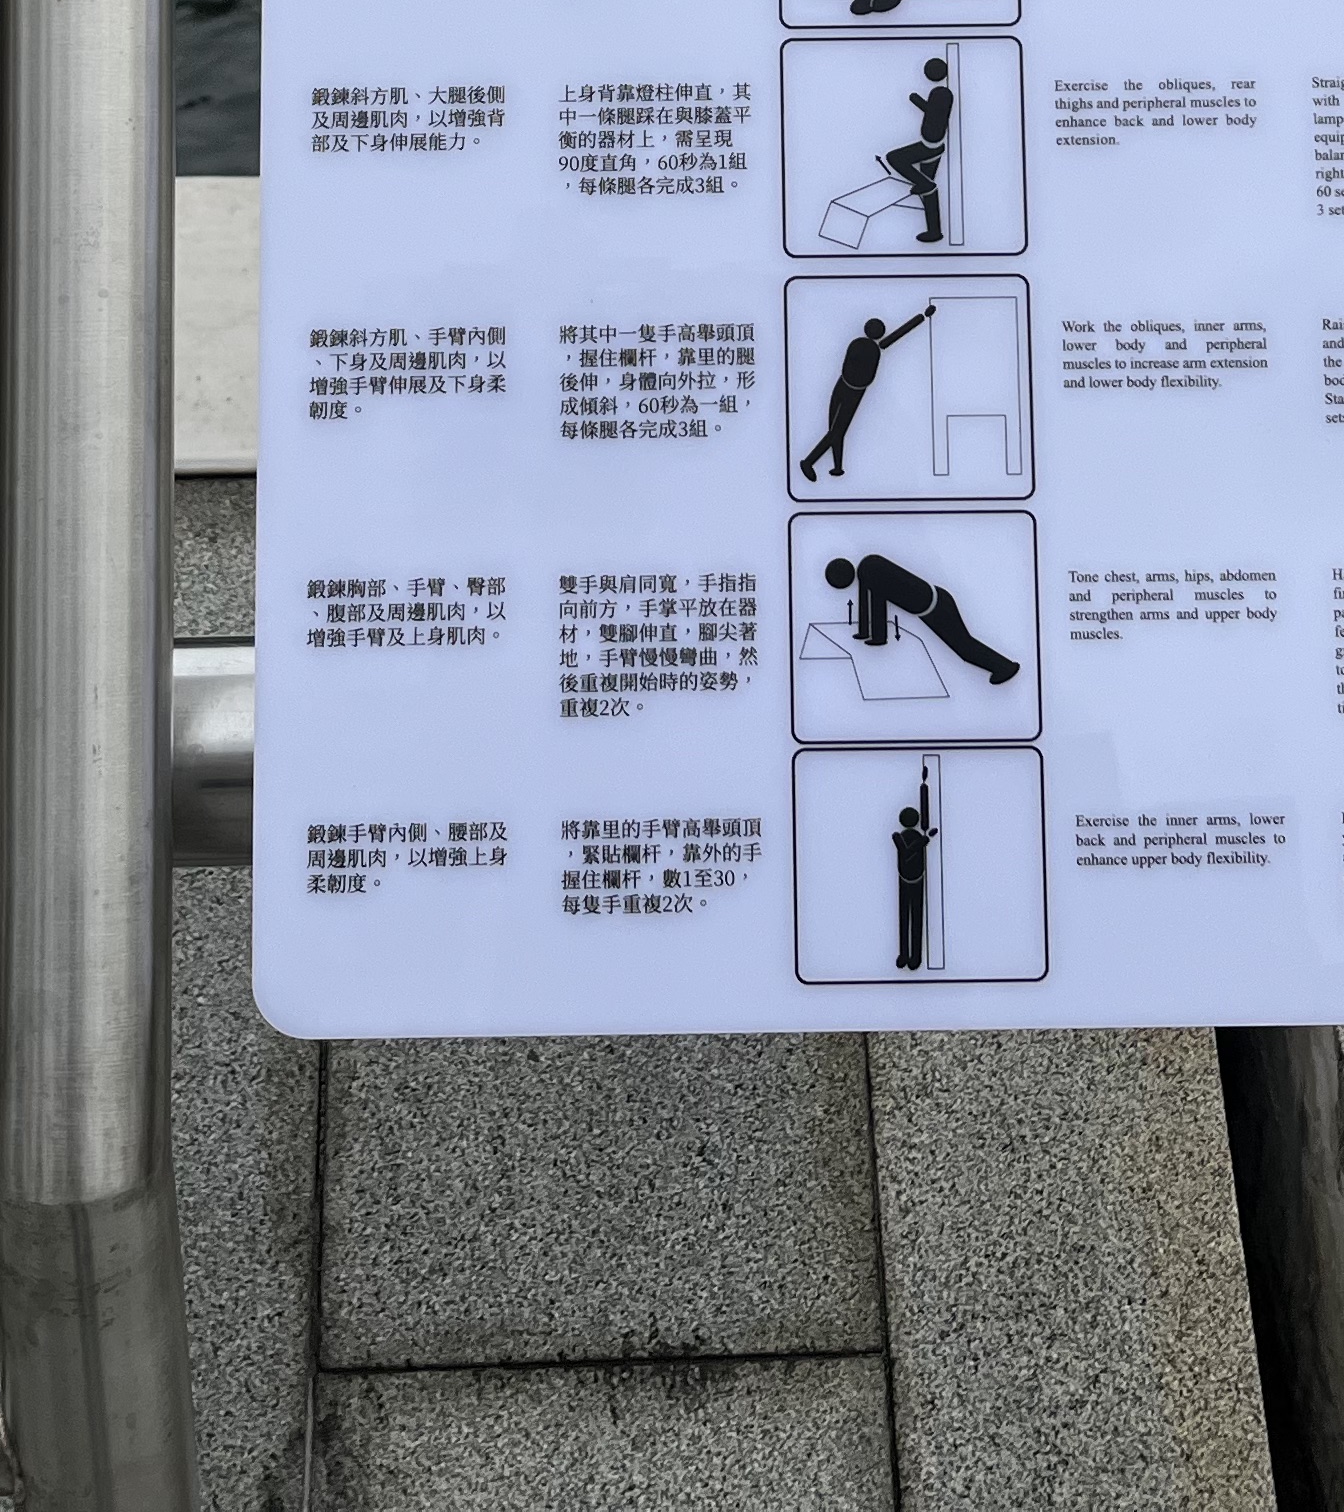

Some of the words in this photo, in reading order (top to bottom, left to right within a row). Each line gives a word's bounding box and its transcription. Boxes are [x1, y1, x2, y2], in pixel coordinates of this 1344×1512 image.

[1053, 79, 1109, 92] Exercise
[1123, 78, 1143, 91] the
[1158, 77, 1216, 94] obliques,
[1230, 80, 1257, 90] rear
[1312, 112, 1344, 128] lamp
[1062, 338, 1098, 352] lower
[1114, 338, 1146, 354] body
[1164, 337, 1188, 351] and
[1205, 336, 1268, 354] peripheral
[1067, 570, 1100, 584] Tone
[1104, 569, 1140, 584] chest,
[1145, 572, 1180, 585] arms,
[1183, 568, 1215, 586] hips,
[1219, 568, 1278, 582] abdomen
[1069, 607, 1134, 625] strengthen
[1139, 610, 1171, 621] arms
[1176, 606, 1200, 621] and
[1204, 610, 1241, 624] upper
[1245, 605, 1278, 623] body
[1075, 814, 1130, 828] Exercise
[1137, 813, 1158, 827] the
[1165, 816, 1199, 827] inner
[1206, 816, 1241, 827] arms,
[1249, 812, 1286, 826] lower
